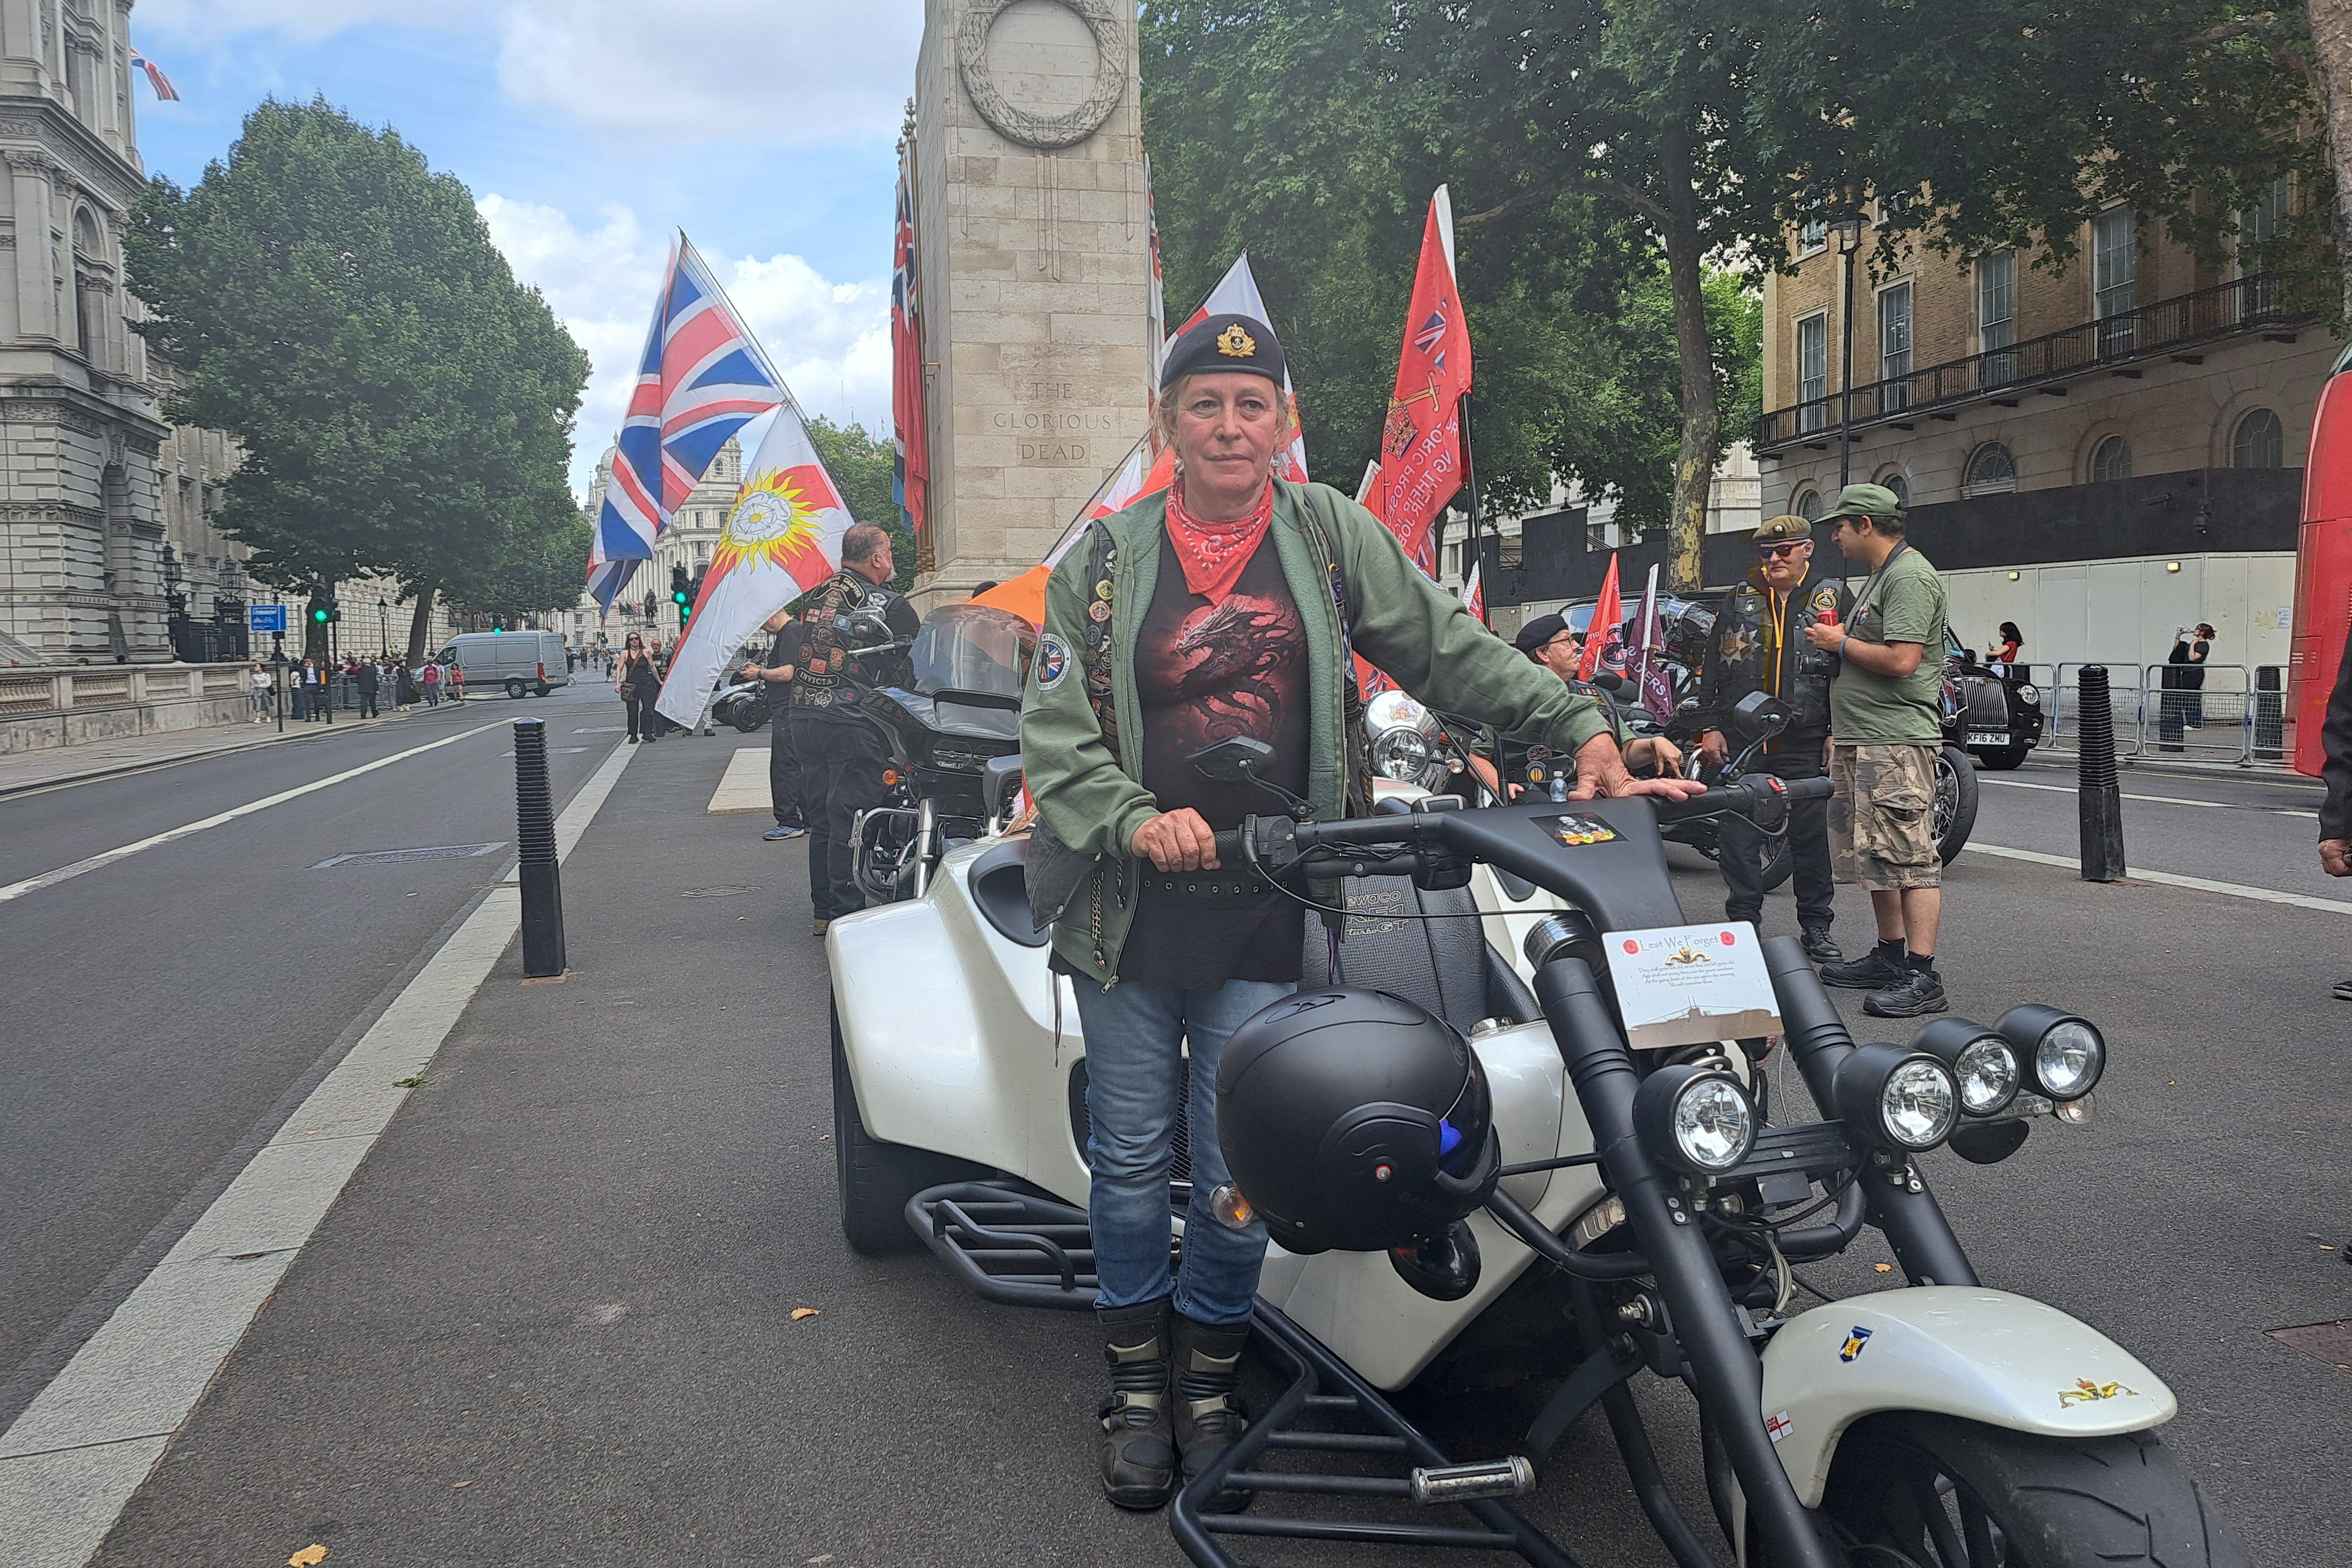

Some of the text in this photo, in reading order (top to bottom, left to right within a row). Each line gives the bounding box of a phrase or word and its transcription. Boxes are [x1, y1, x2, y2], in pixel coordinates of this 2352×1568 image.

[1030, 382, 1072, 398] THE
[994, 413, 1111, 429] GLORIOUS
[1021, 444, 1085, 460] DEAD
[799, 671, 833, 685] INVICTA
[1967, 734, 2005, 743] KF16 ZMU
[1345, 890, 1401, 907] ewaco
[1639, 935, 1719, 951] Lest We Forget
